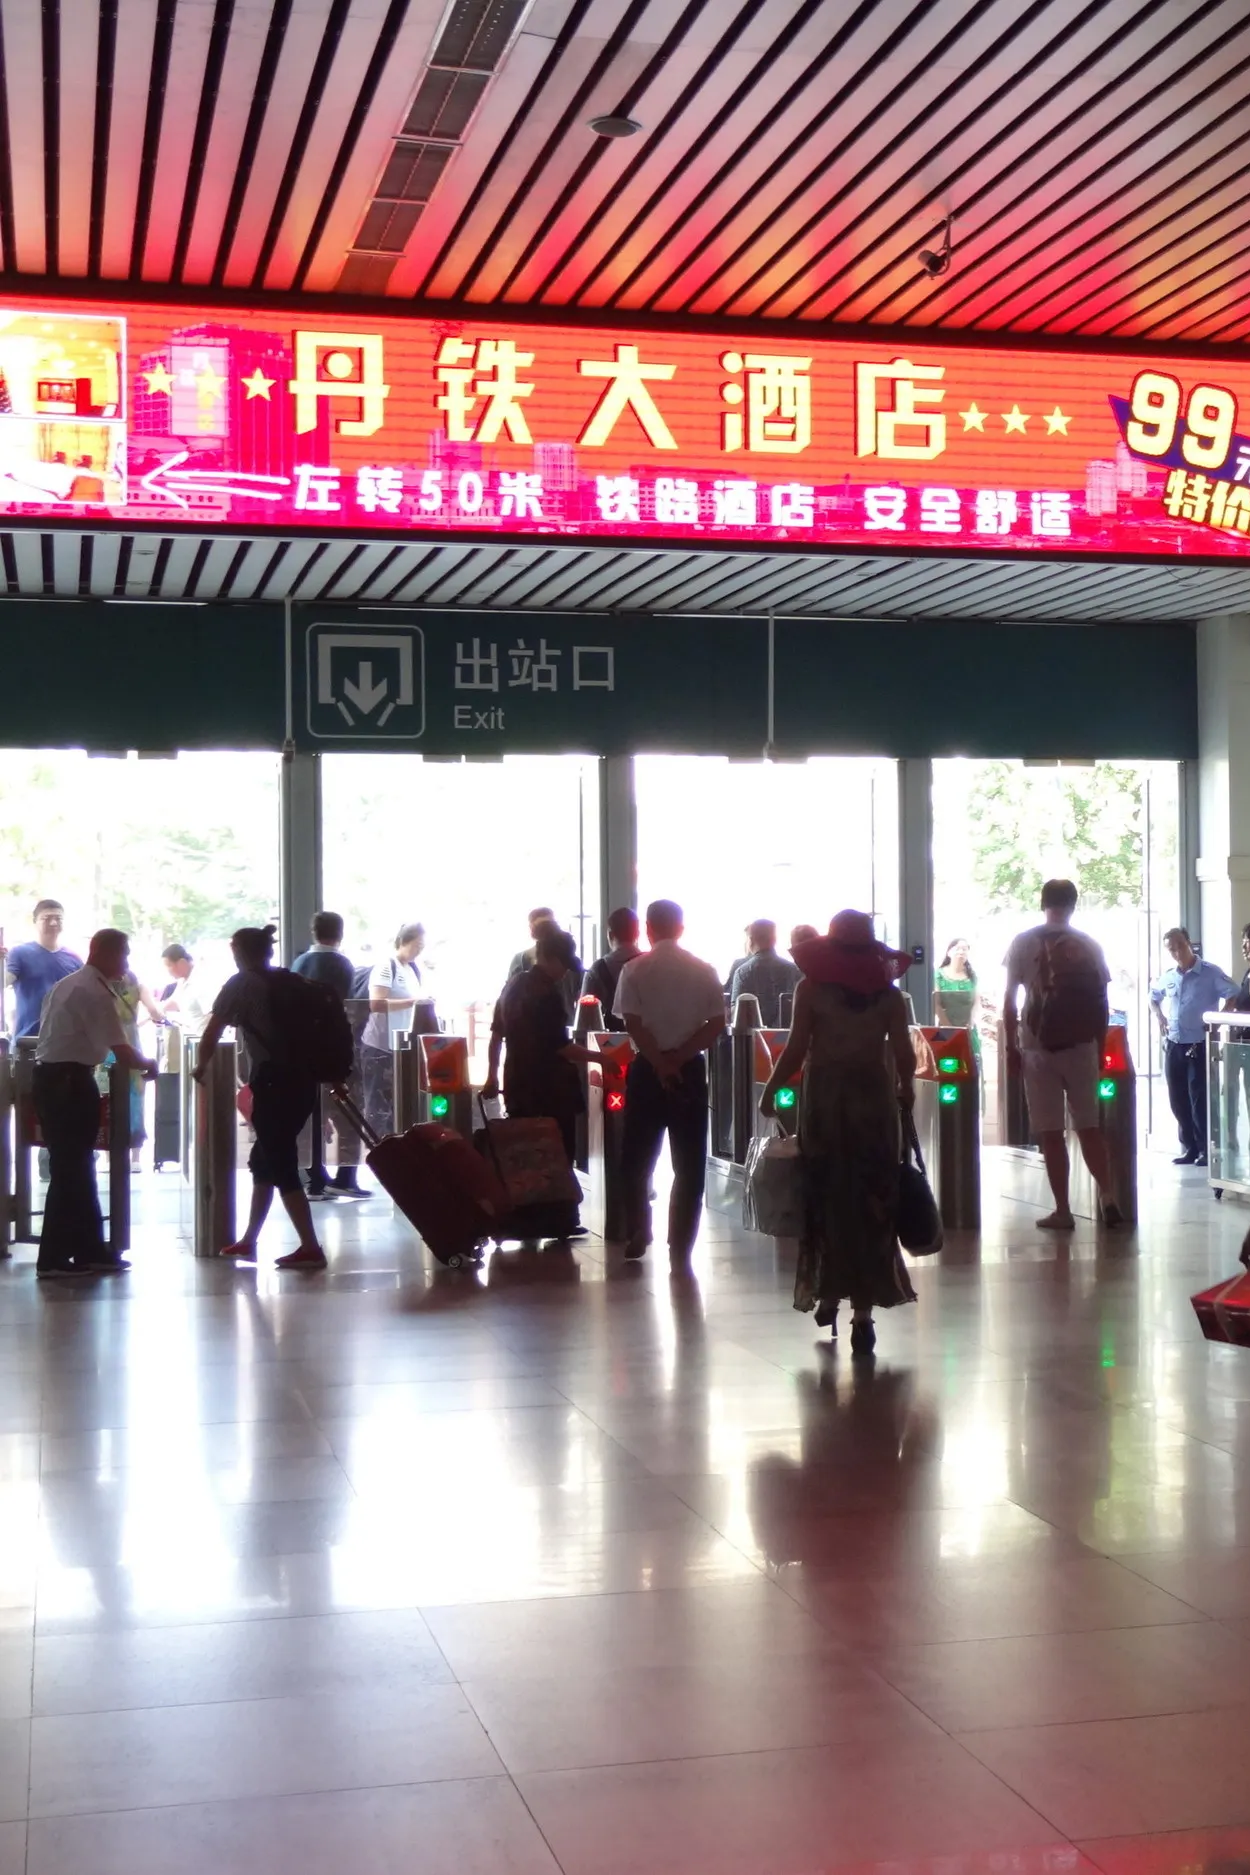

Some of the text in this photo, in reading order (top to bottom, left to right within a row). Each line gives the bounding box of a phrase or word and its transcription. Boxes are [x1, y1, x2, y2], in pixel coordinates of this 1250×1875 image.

[289, 329, 947, 461] 丹铁大酒店
[1127, 372, 1237, 470] 99
[293, 463, 1072, 537] 左转50米 铁路酒店 安全舒适
[454, 637, 615, 693] 出站口
[453, 705, 506, 730] Exit
